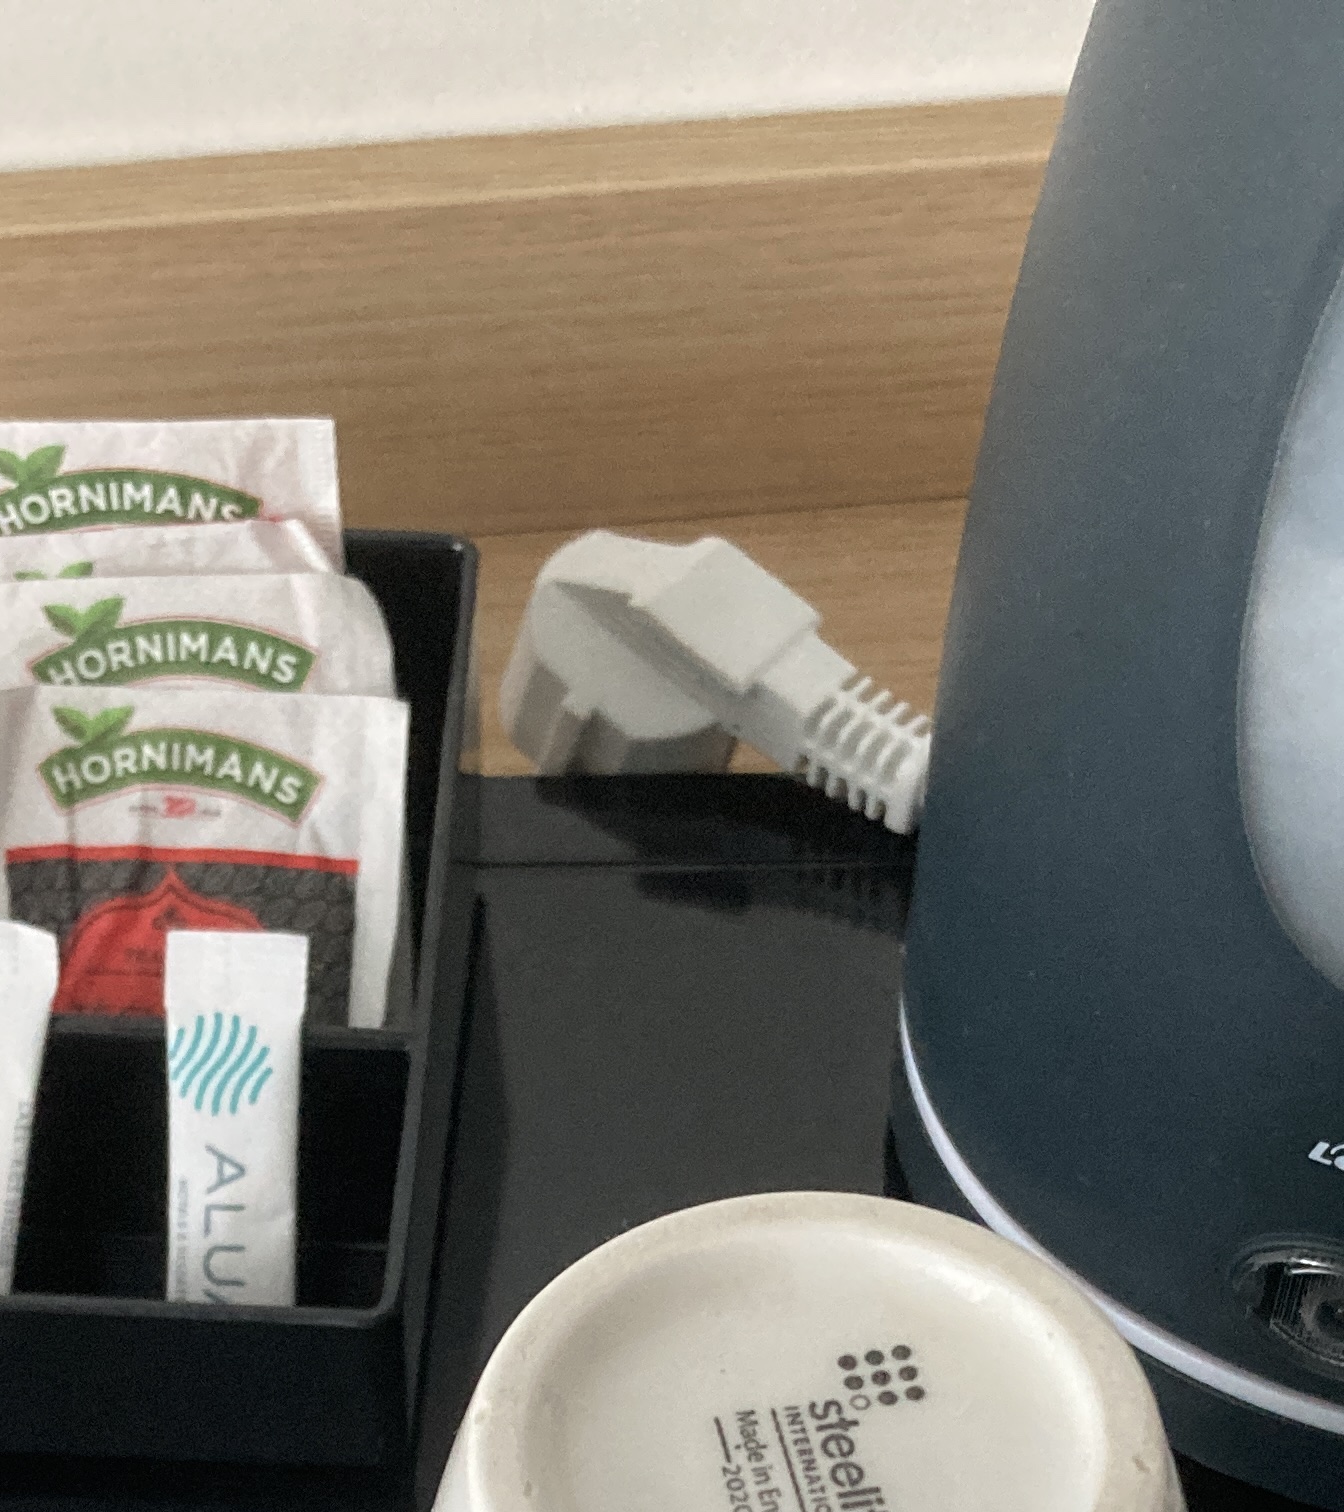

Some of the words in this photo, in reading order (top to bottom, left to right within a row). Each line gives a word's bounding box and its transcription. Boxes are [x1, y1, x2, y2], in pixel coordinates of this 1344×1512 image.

[47, 632, 298, 686] HORNIMANS
[52, 741, 304, 805] HORNIMANS
[736, 1409, 768, 1463] Made
[751, 1465, 774, 1485] in
